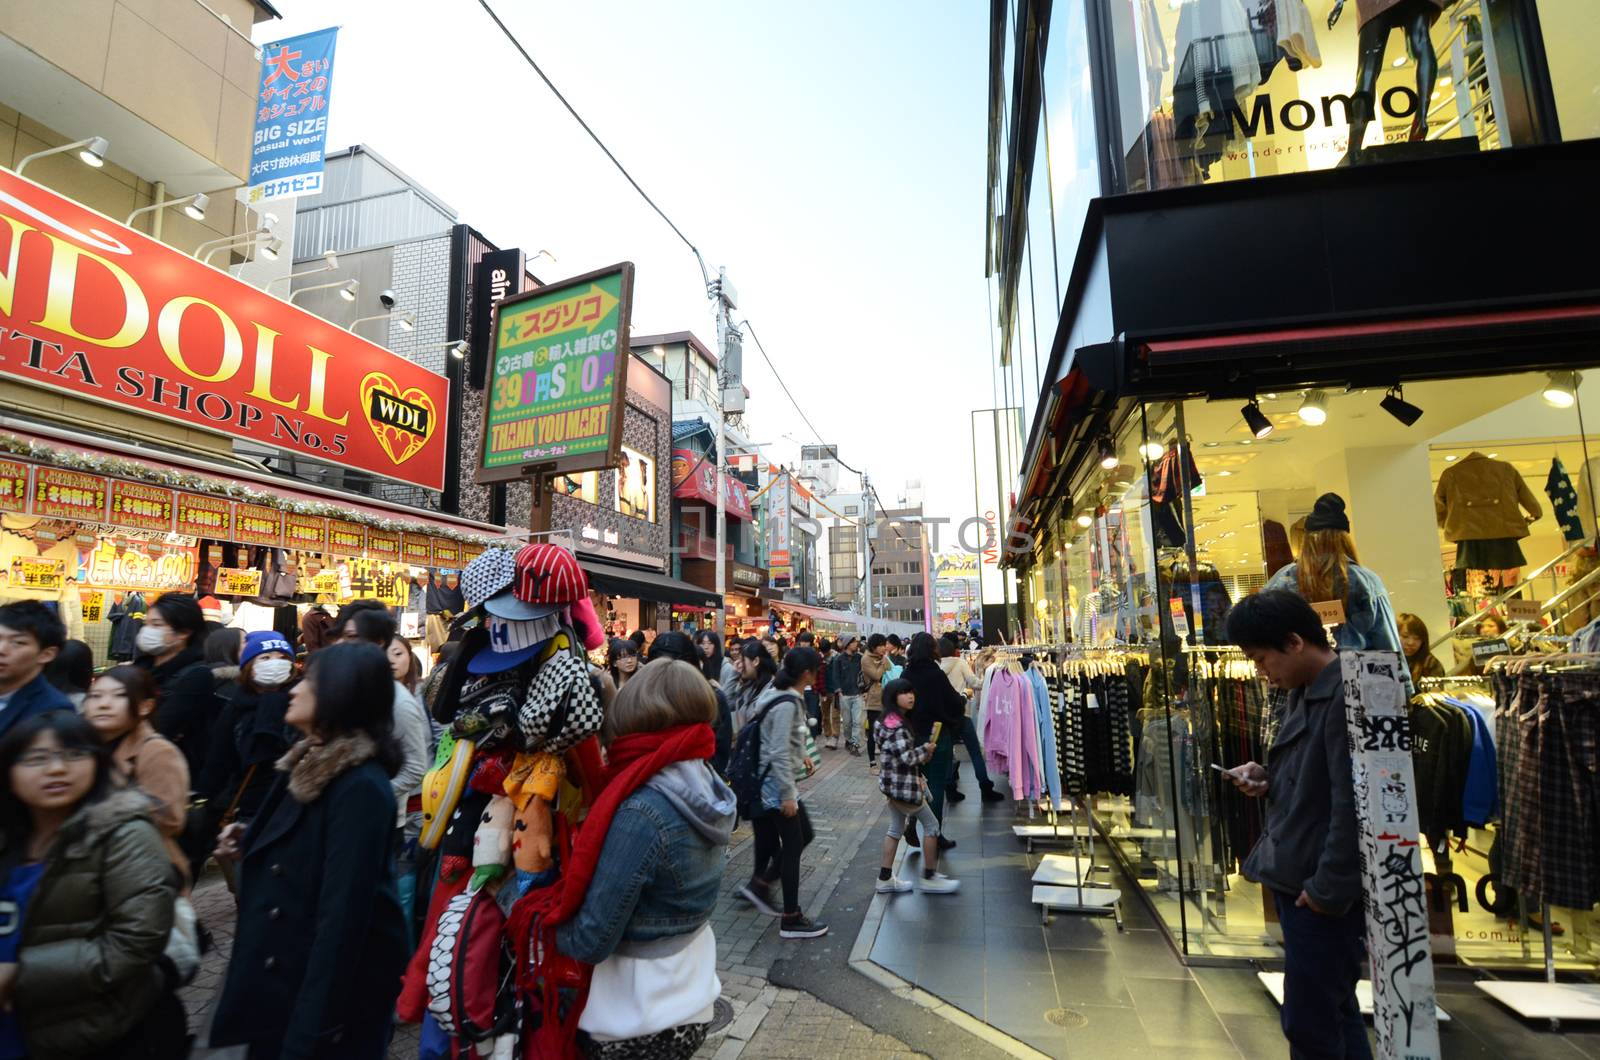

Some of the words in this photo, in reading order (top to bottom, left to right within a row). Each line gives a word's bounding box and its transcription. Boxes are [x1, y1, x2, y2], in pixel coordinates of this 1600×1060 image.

[260, 76, 327, 103] サイズの
[258, 95, 325, 123] カジュアル
[254, 124, 281, 146] BIG
[286, 116, 326, 137] SIZE
[254, 138, 288, 155] casual
[292, 133, 322, 146] wear
[523, 295, 602, 338] スグソコ
[116, 366, 263, 430] SHOP
[272, 412, 349, 456] No.5
[377, 395, 427, 433] WDL
[491, 418, 536, 452] THANK
[538, 413, 566, 446] YOU
[566, 404, 610, 440] MART
[261, 639, 290, 651] NYC
[492, 622, 509, 645] H
[1364, 732, 1412, 751] 246
[1386, 813, 1408, 822] 17
